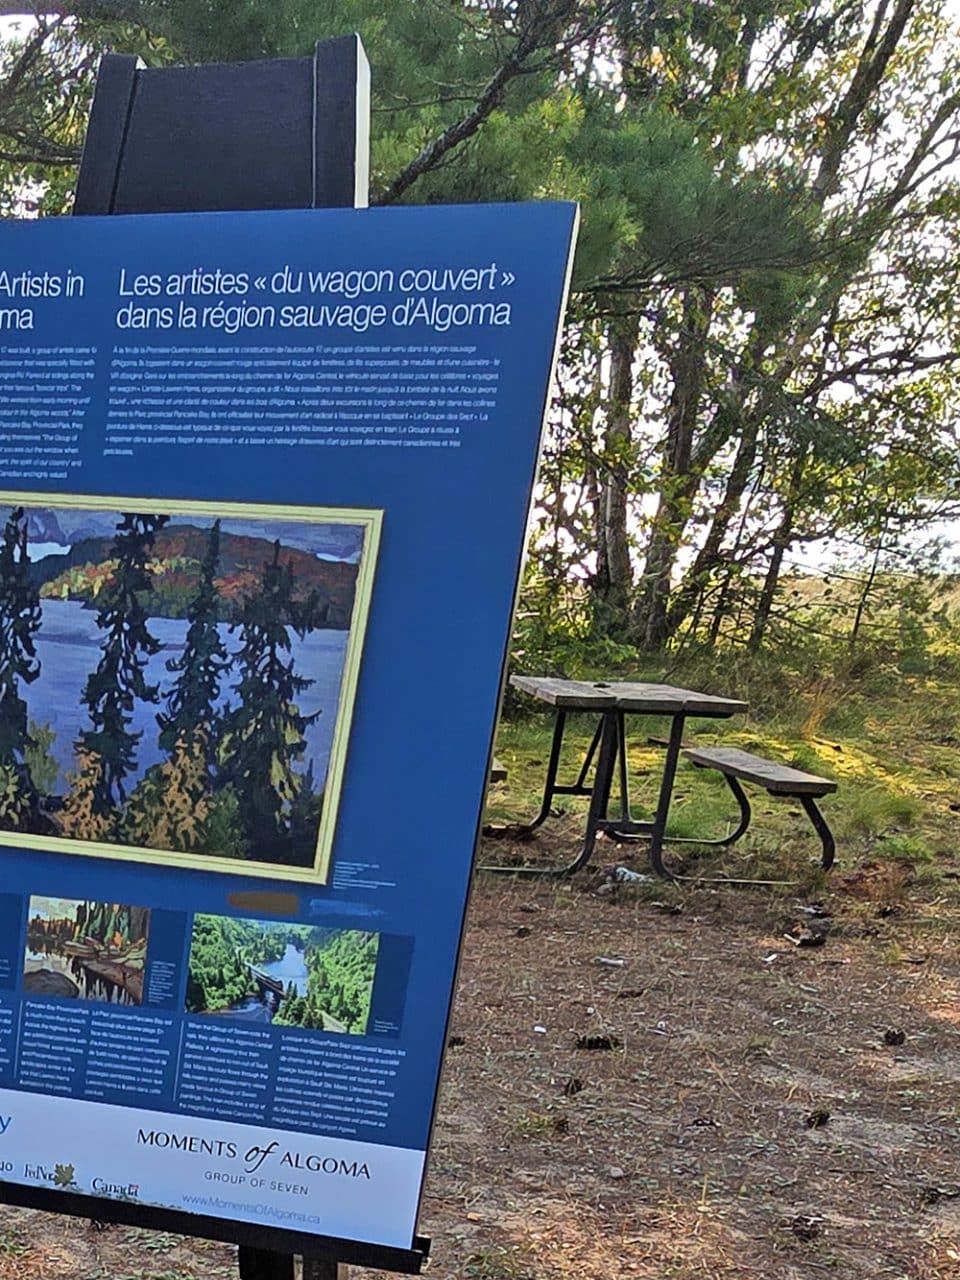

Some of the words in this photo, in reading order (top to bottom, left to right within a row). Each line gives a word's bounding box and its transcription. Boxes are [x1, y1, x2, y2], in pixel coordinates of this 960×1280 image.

[66, 269, 84, 296] in
[119, 268, 161, 296] Les
[165, 267, 249, 295] artistes
[271, 265, 302, 293] du
[309, 271, 393, 299] wagon
[398, 263, 497, 291] couvert
[116, 301, 171, 329] dans
[177, 301, 196, 329] la
[201, 300, 275, 333] région
[279, 307, 385, 331] sauvage
[391, 299, 511, 332] d’Algoma
[137, 1128, 237, 1159] MOMENTS
[244, 1141, 279, 1173] of
[281, 1152, 370, 1179] ALGOMA
[92, 1177, 139, 1197] Canada
[204, 1170, 246, 1186] GROUP
[250, 1177, 266, 1188] OF
[270, 1179, 309, 1195] SEVEN
